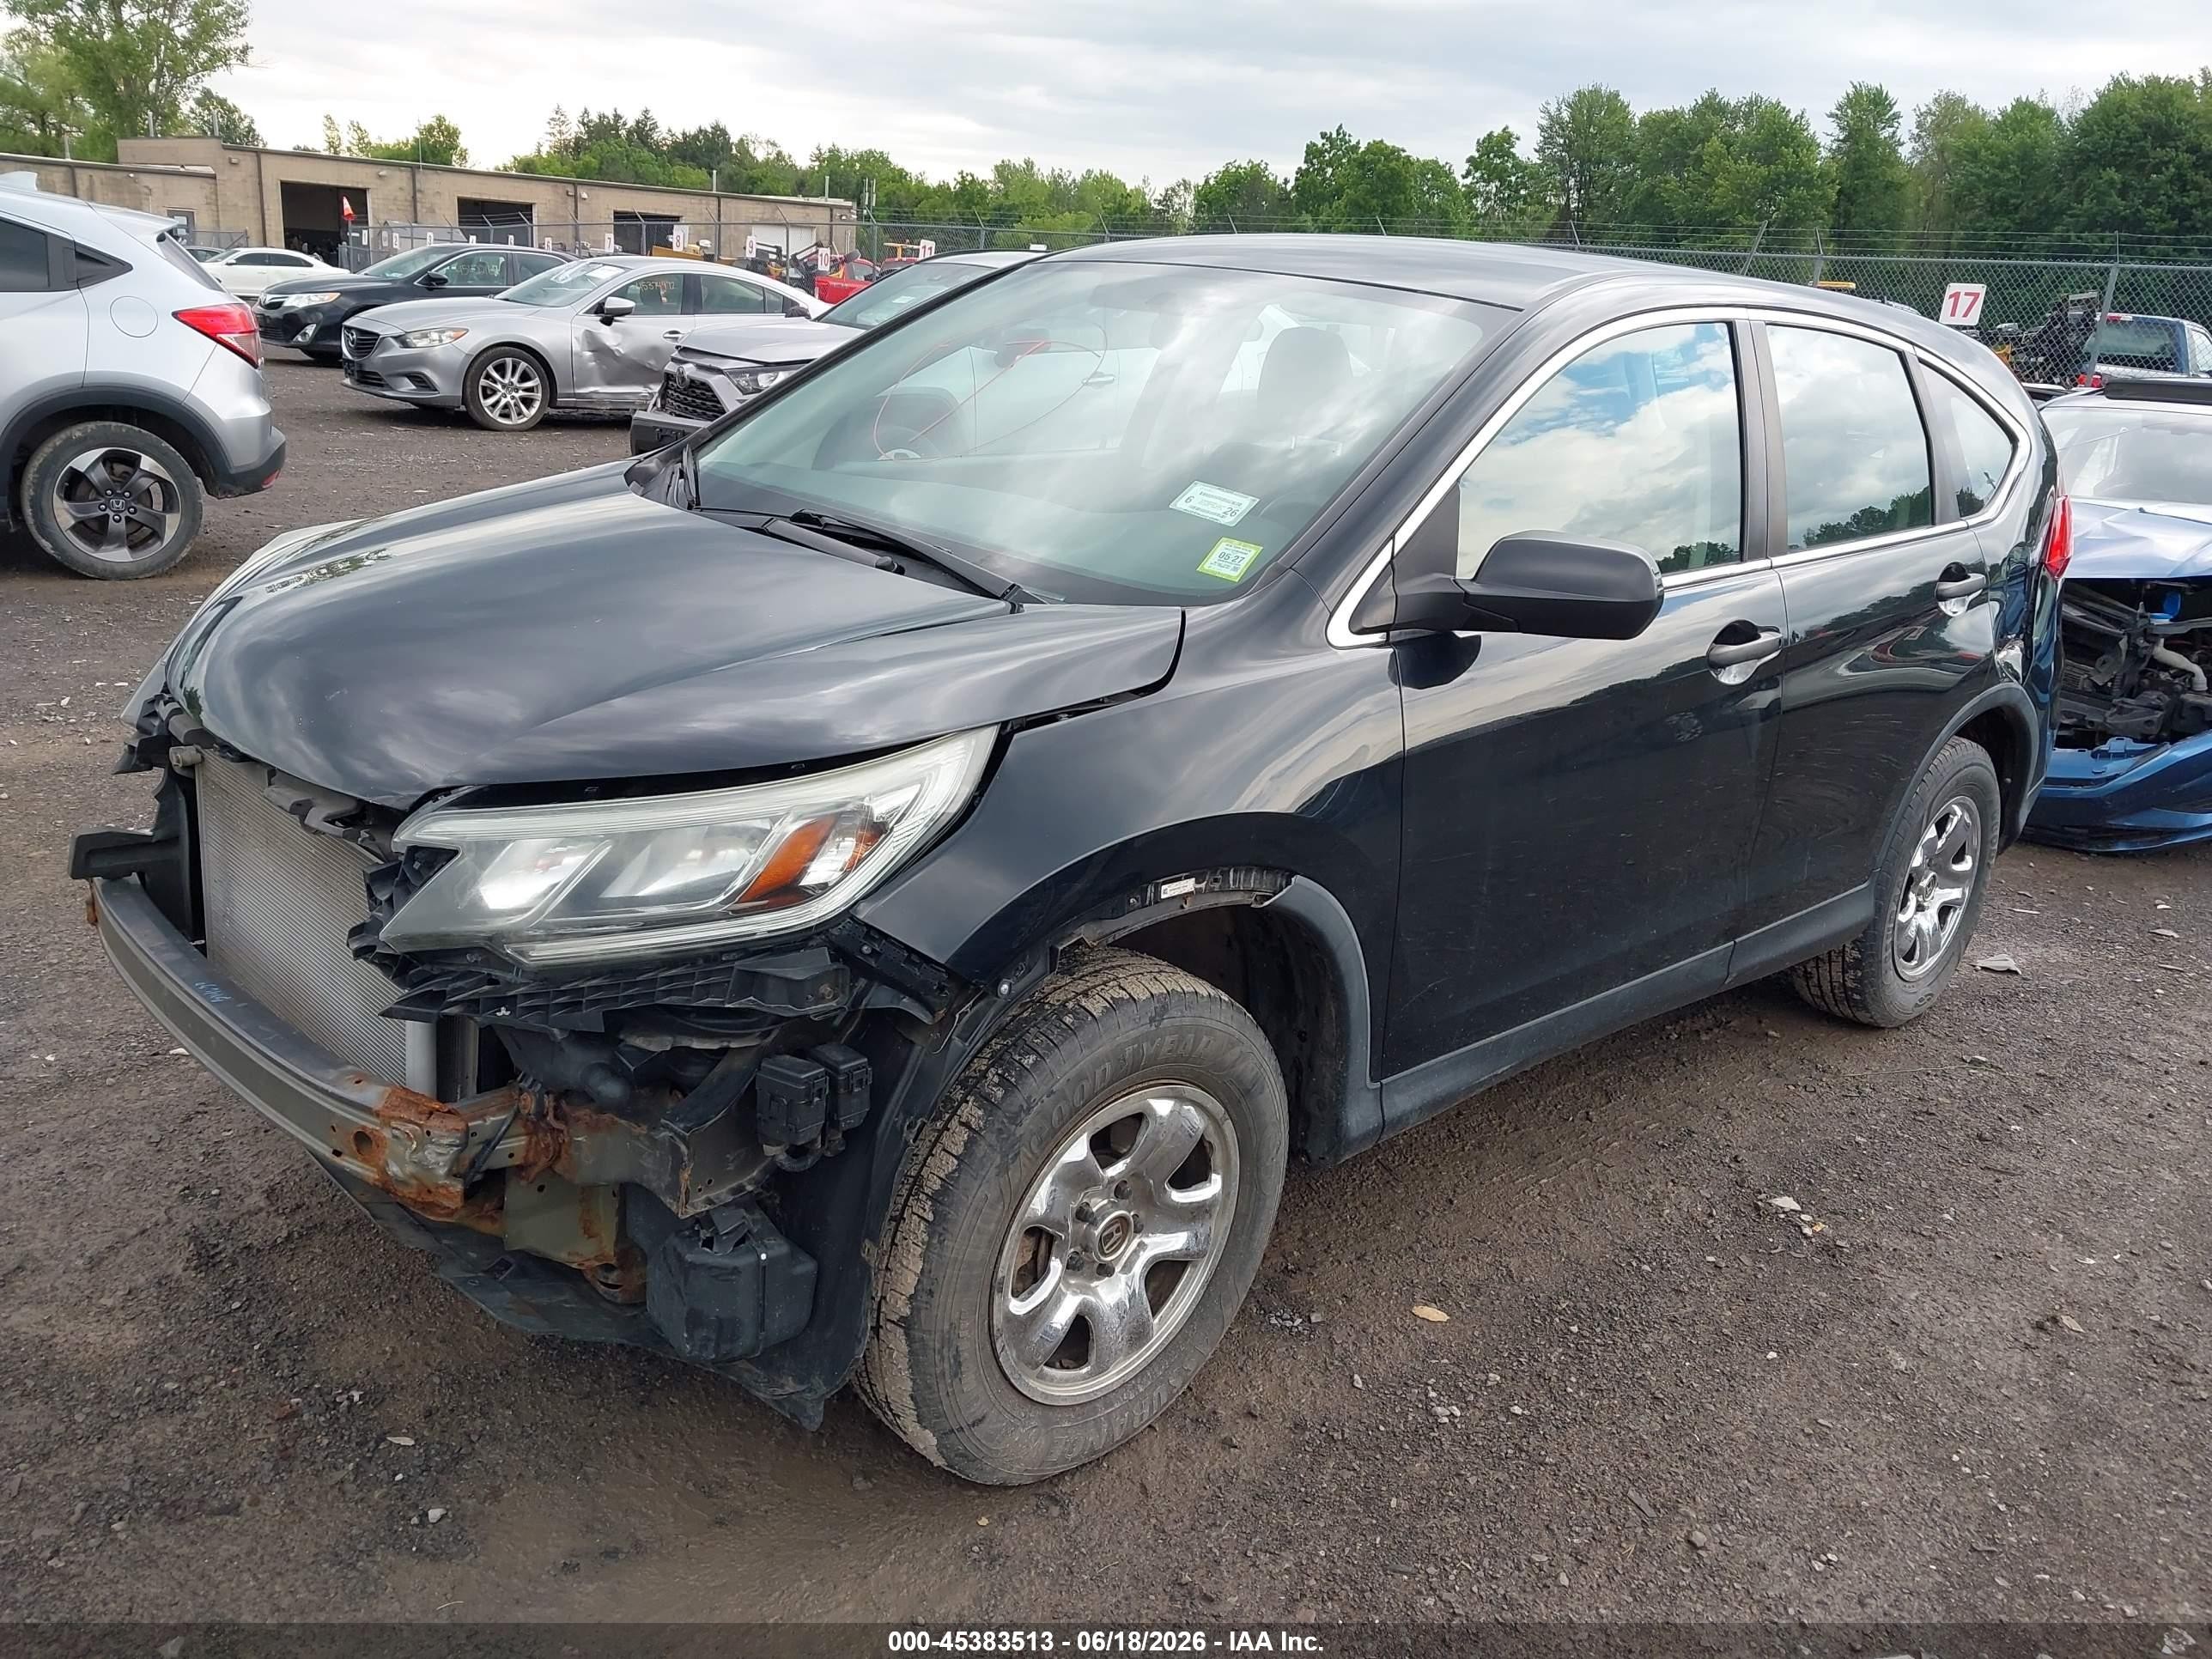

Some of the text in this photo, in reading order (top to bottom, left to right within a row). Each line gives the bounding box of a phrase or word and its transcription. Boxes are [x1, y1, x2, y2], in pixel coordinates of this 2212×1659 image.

[675, 234, 681, 248] 8
[748, 240, 754, 254] 9
[921, 245, 934, 258] 11
[819, 252, 830, 266] 10
[1948, 291, 1980, 318] 17
[1222, 507, 1240, 517] 26
